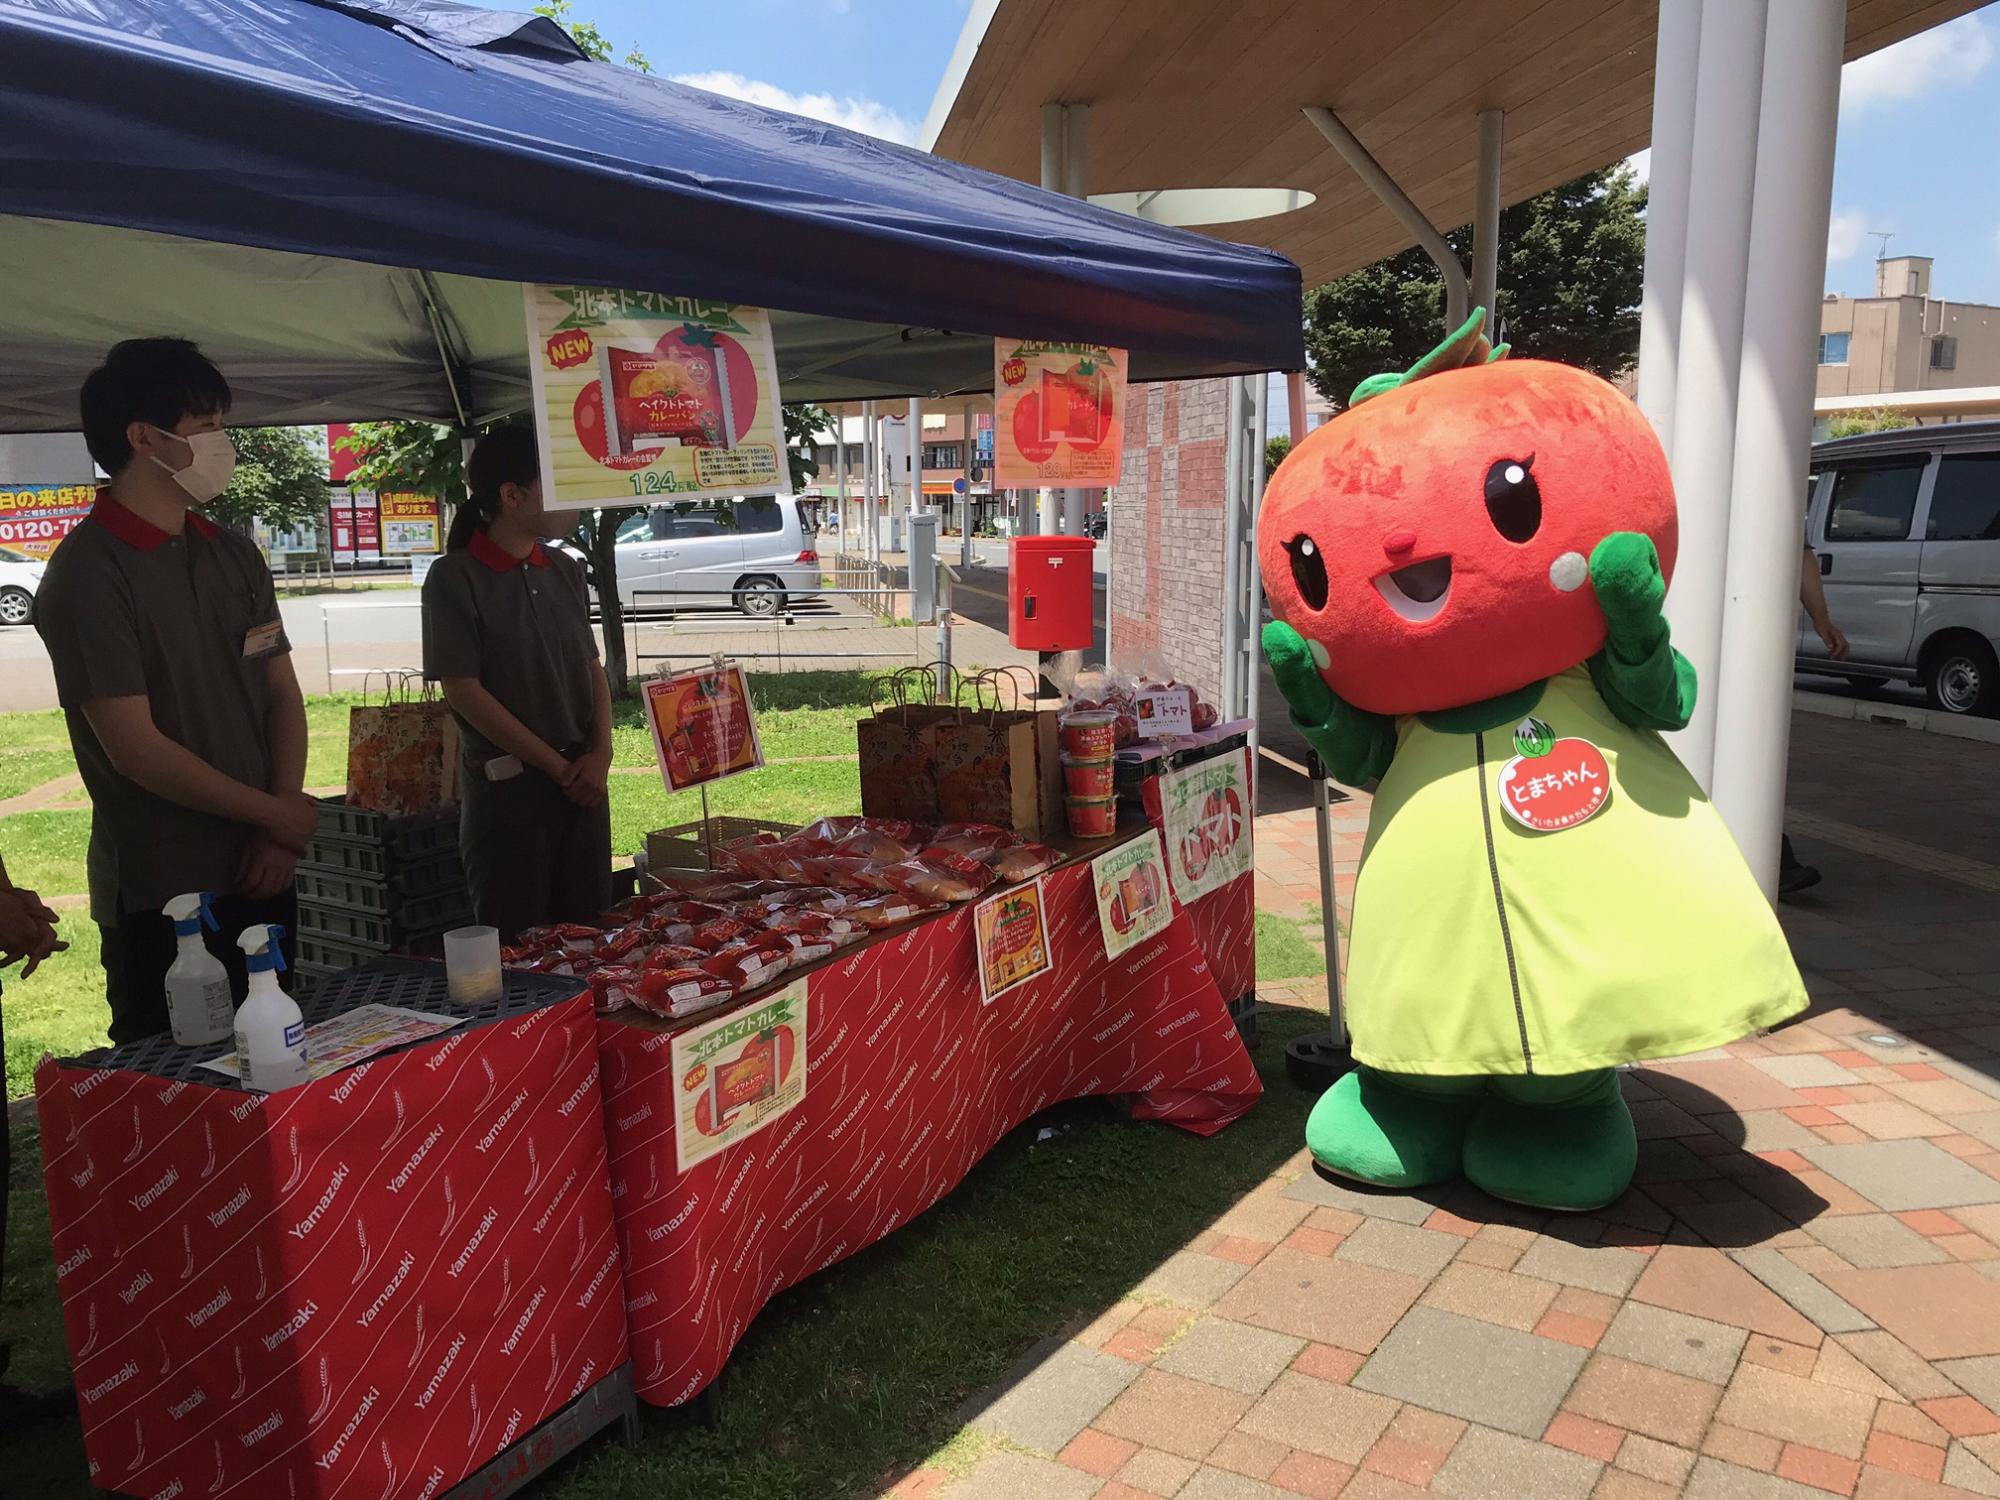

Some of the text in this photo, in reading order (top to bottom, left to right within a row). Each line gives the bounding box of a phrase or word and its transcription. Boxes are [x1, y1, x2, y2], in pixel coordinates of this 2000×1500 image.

[551, 338, 590, 363] NEW
[1004, 363, 1025, 382] NEW
[629, 469, 677, 495] 124
[1162, 704, 1187, 717] トマト
[1511, 761, 1599, 803] とまちゃん
[1184, 802, 1242, 862] トマト
[1127, 941, 1168, 976] Yamazaki
[916, 971, 949, 1021] Yamazaki
[1009, 989, 1040, 1032] Yamazaki
[1051, 971, 1081, 1012] Yamazaki
[512, 1005, 555, 1041] Yama
[640, 1031, 675, 1054] Yama
[699, 1007, 790, 1058] 北本トマトカレー
[865, 997, 904, 1048] Yamazaki
[1092, 1008, 1135, 1044] Yamazaki
[1155, 1008, 1201, 1039] Yamazaki
[806, 1022, 849, 1075] Yamazaki
[930, 1033, 963, 1083] Yamazaki
[685, 1067, 707, 1090] NEW
[884, 1060, 919, 1112] Yamazaki
[476, 1087, 529, 1155] Yamazaki
[617, 1103, 653, 1133] Yamazaki
[827, 1089, 870, 1141] Yamazaki
[386, 1123, 445, 1195] Yamazaki
[765, 1115, 808, 1170] Yamazaki
[898, 1120, 933, 1171] Yamazaki
[128, 1164, 180, 1213] Yamazaki
[288, 1161, 351, 1241] Yamazaki
[532, 1167, 578, 1235] Yamazaki
[719, 1152, 756, 1215] Yamazaki
[847, 1151, 886, 1203] Yamazaki
[206, 1183, 252, 1230] Yamazaki
[645, 1192, 700, 1243] Yamazaki
[781, 1180, 829, 1231] Yamazaki
[447, 1206, 499, 1280] Yamazaki
[733, 1212, 768, 1274] Yamazaki
[356, 1250, 416, 1329] Yamazaki
[576, 1242, 621, 1310] Yamazaki
[185, 1285, 233, 1329] Yamazaki
[261, 1298, 319, 1352] Yamazaki
[500, 1284, 548, 1358] Yamazaki
[81, 1359, 140, 1405] Yamazaki
[414, 1331, 467, 1411] Yamazaki
[167, 1386, 207, 1421] Yamazaki
[238, 1408, 285, 1449] Yamazaki
[315, 1385, 381, 1472] Yamazaki
